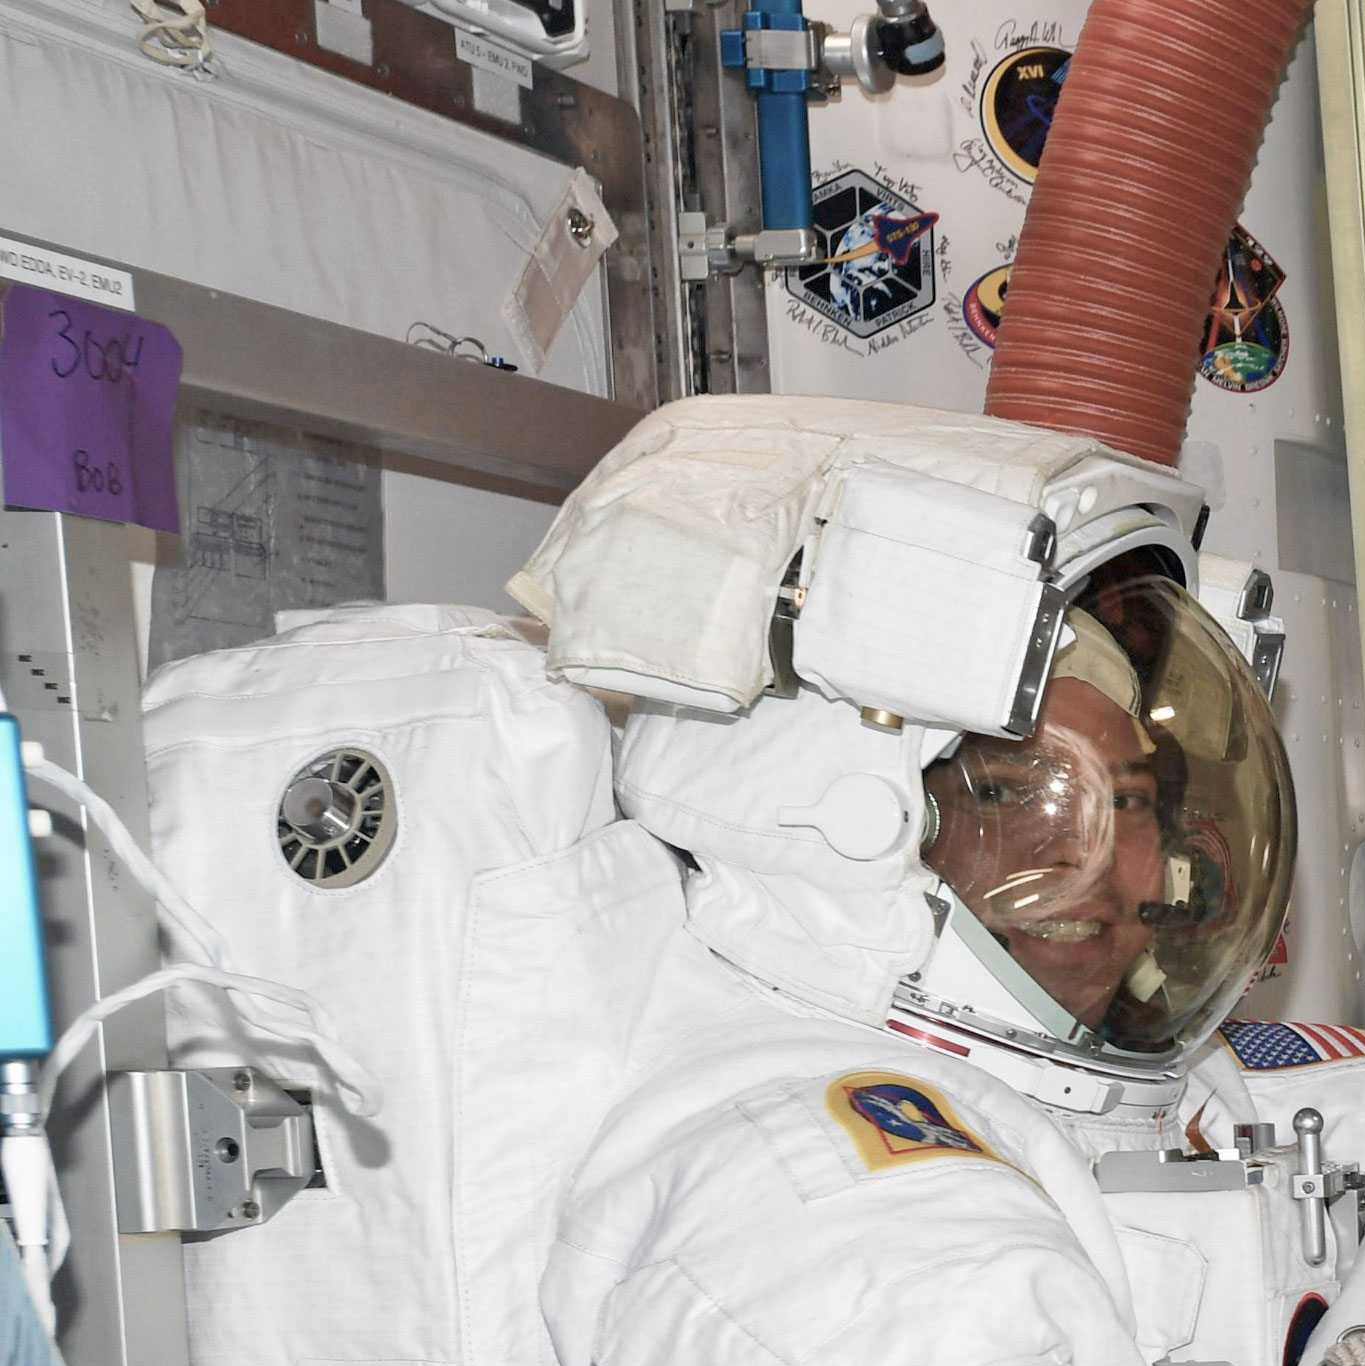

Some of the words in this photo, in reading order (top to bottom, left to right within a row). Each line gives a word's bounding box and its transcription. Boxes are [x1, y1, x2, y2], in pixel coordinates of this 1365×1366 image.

[1016, 65, 1044, 80] XVI
[877, 189, 906, 211] VIRTS
[922, 249, 932, 275] HIRE
[92, 275, 122, 295] EMU2
[803, 292, 852, 326] BEHNKEN
[874, 303, 916, 328] PATRICK
[1213, 375, 1242, 391] MELVIN
